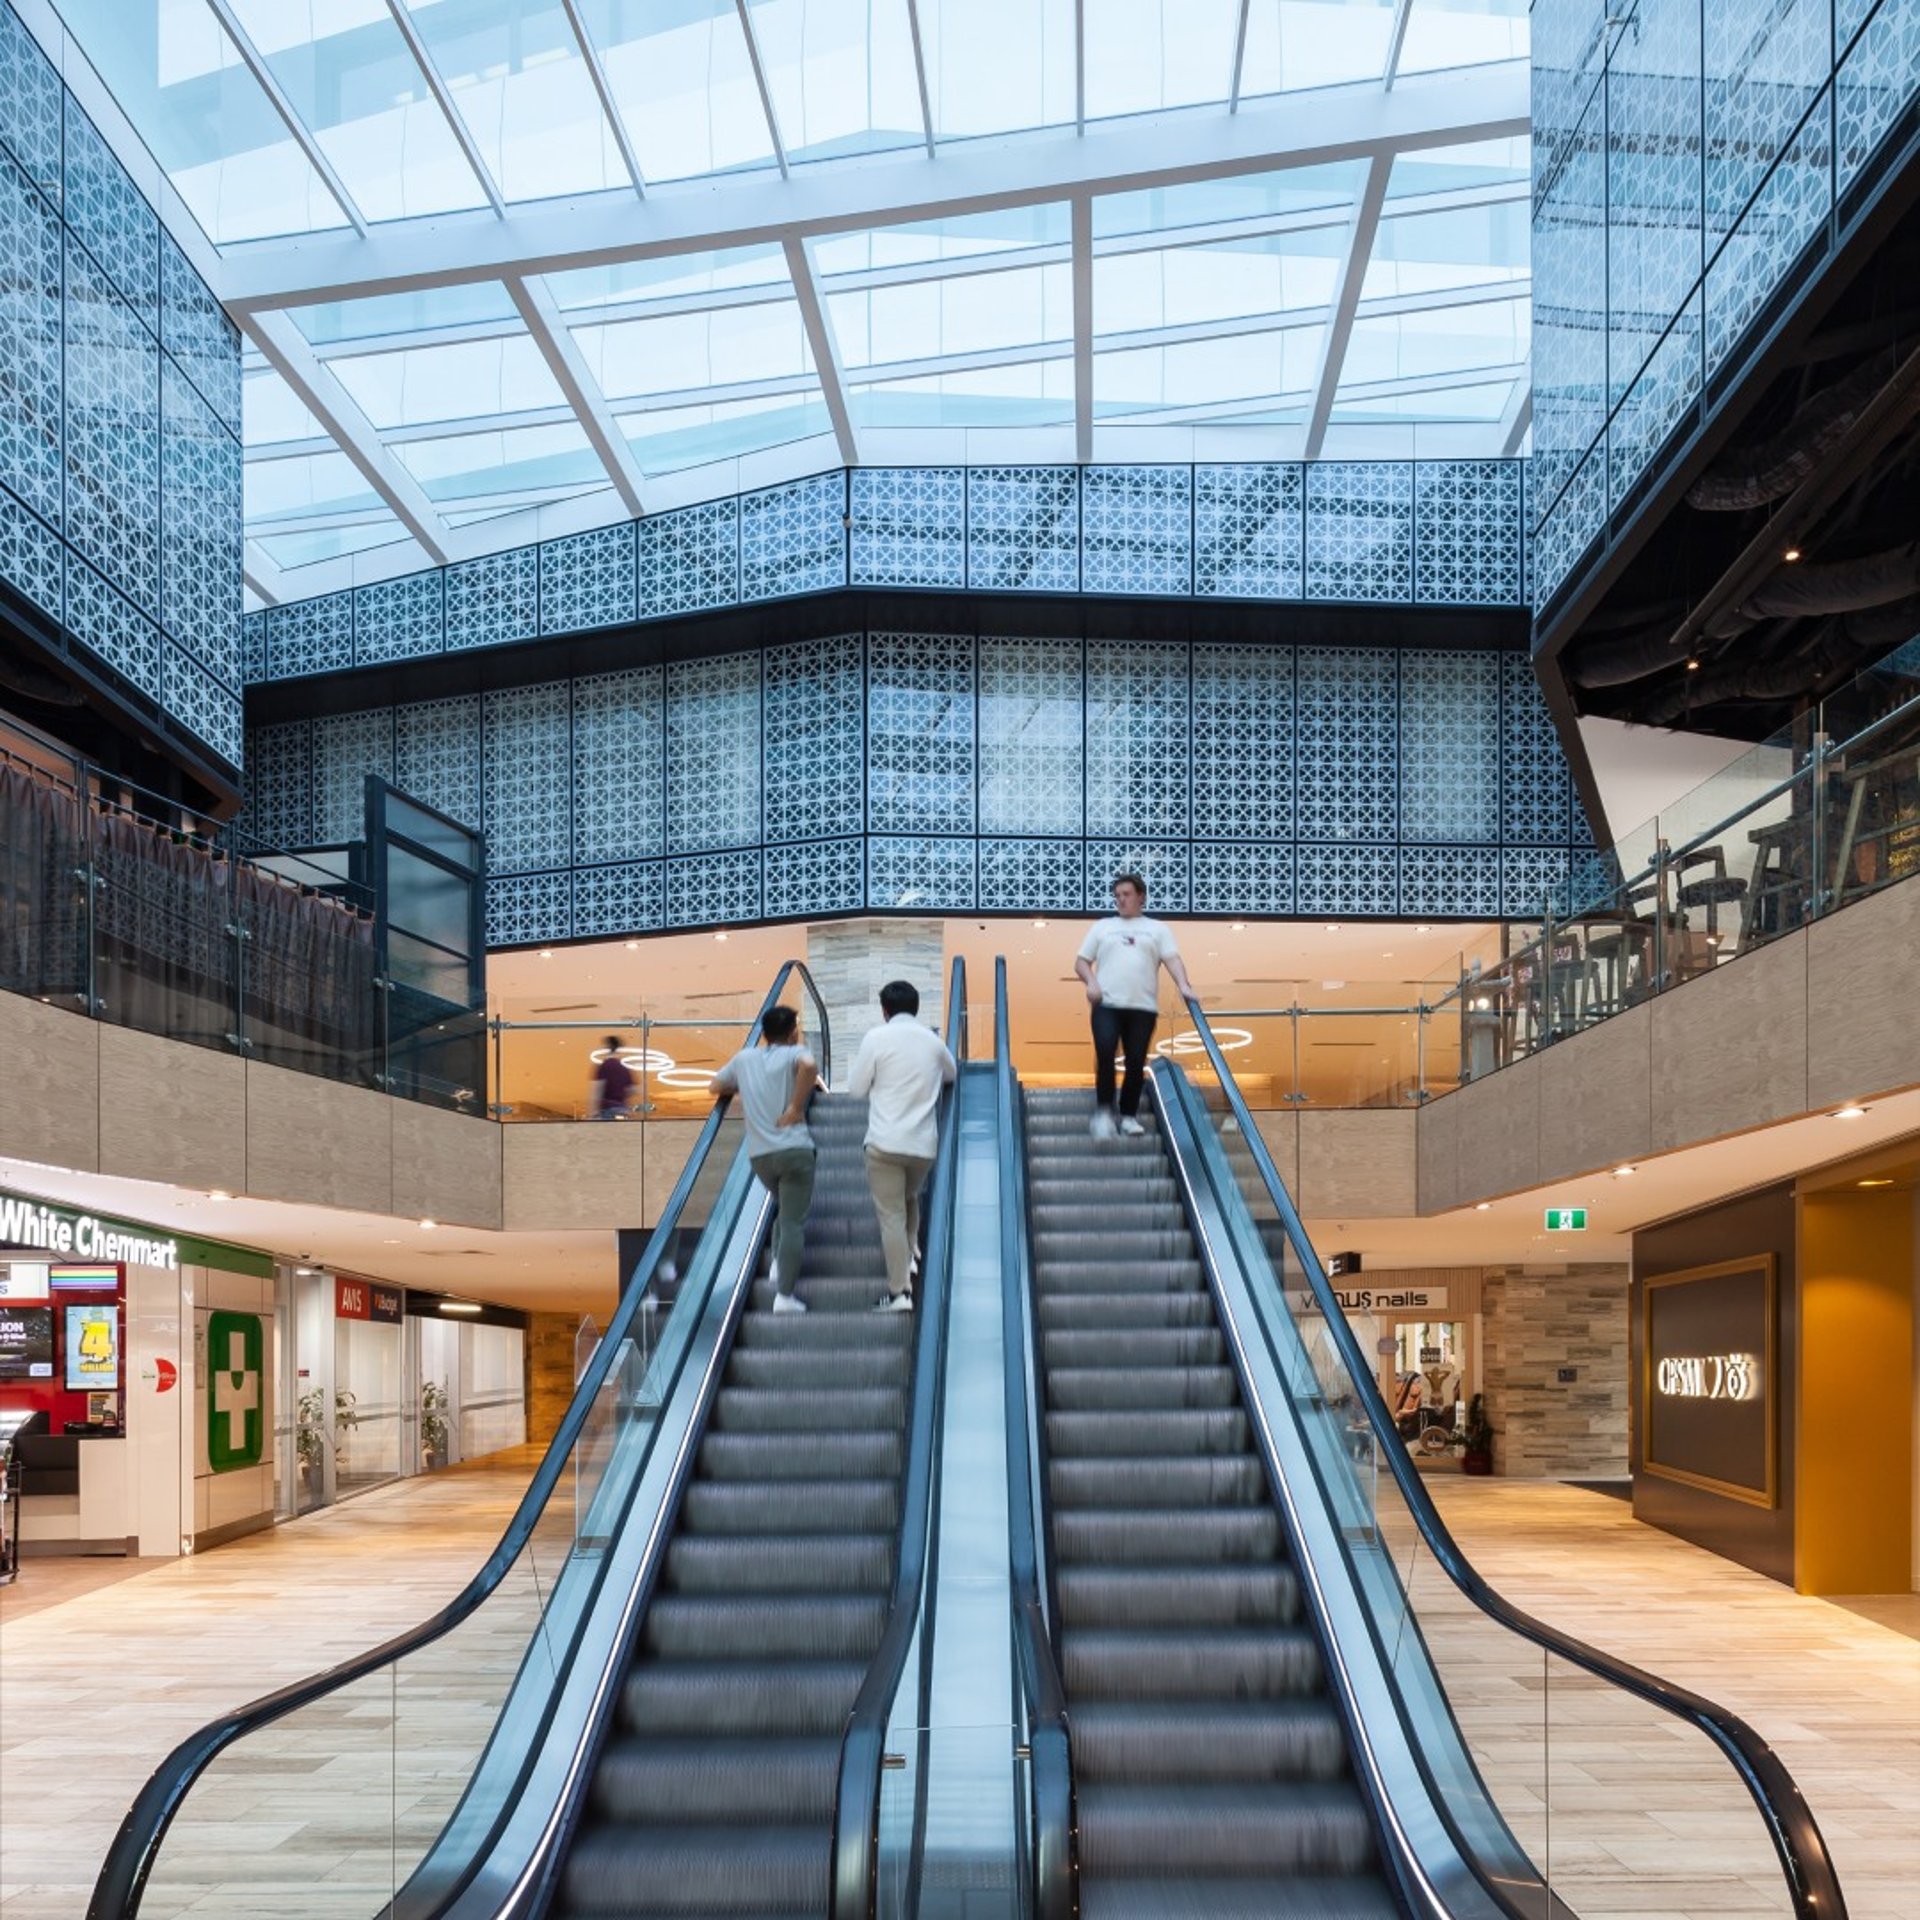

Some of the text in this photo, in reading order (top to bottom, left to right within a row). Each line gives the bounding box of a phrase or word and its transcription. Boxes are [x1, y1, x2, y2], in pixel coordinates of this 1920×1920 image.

[0, 1197, 176, 1270] White Chemmart
[342, 1286, 362, 1312] AVIS
[1376, 1291, 1428, 1306] nails
[80, 1322, 114, 1359] 4
